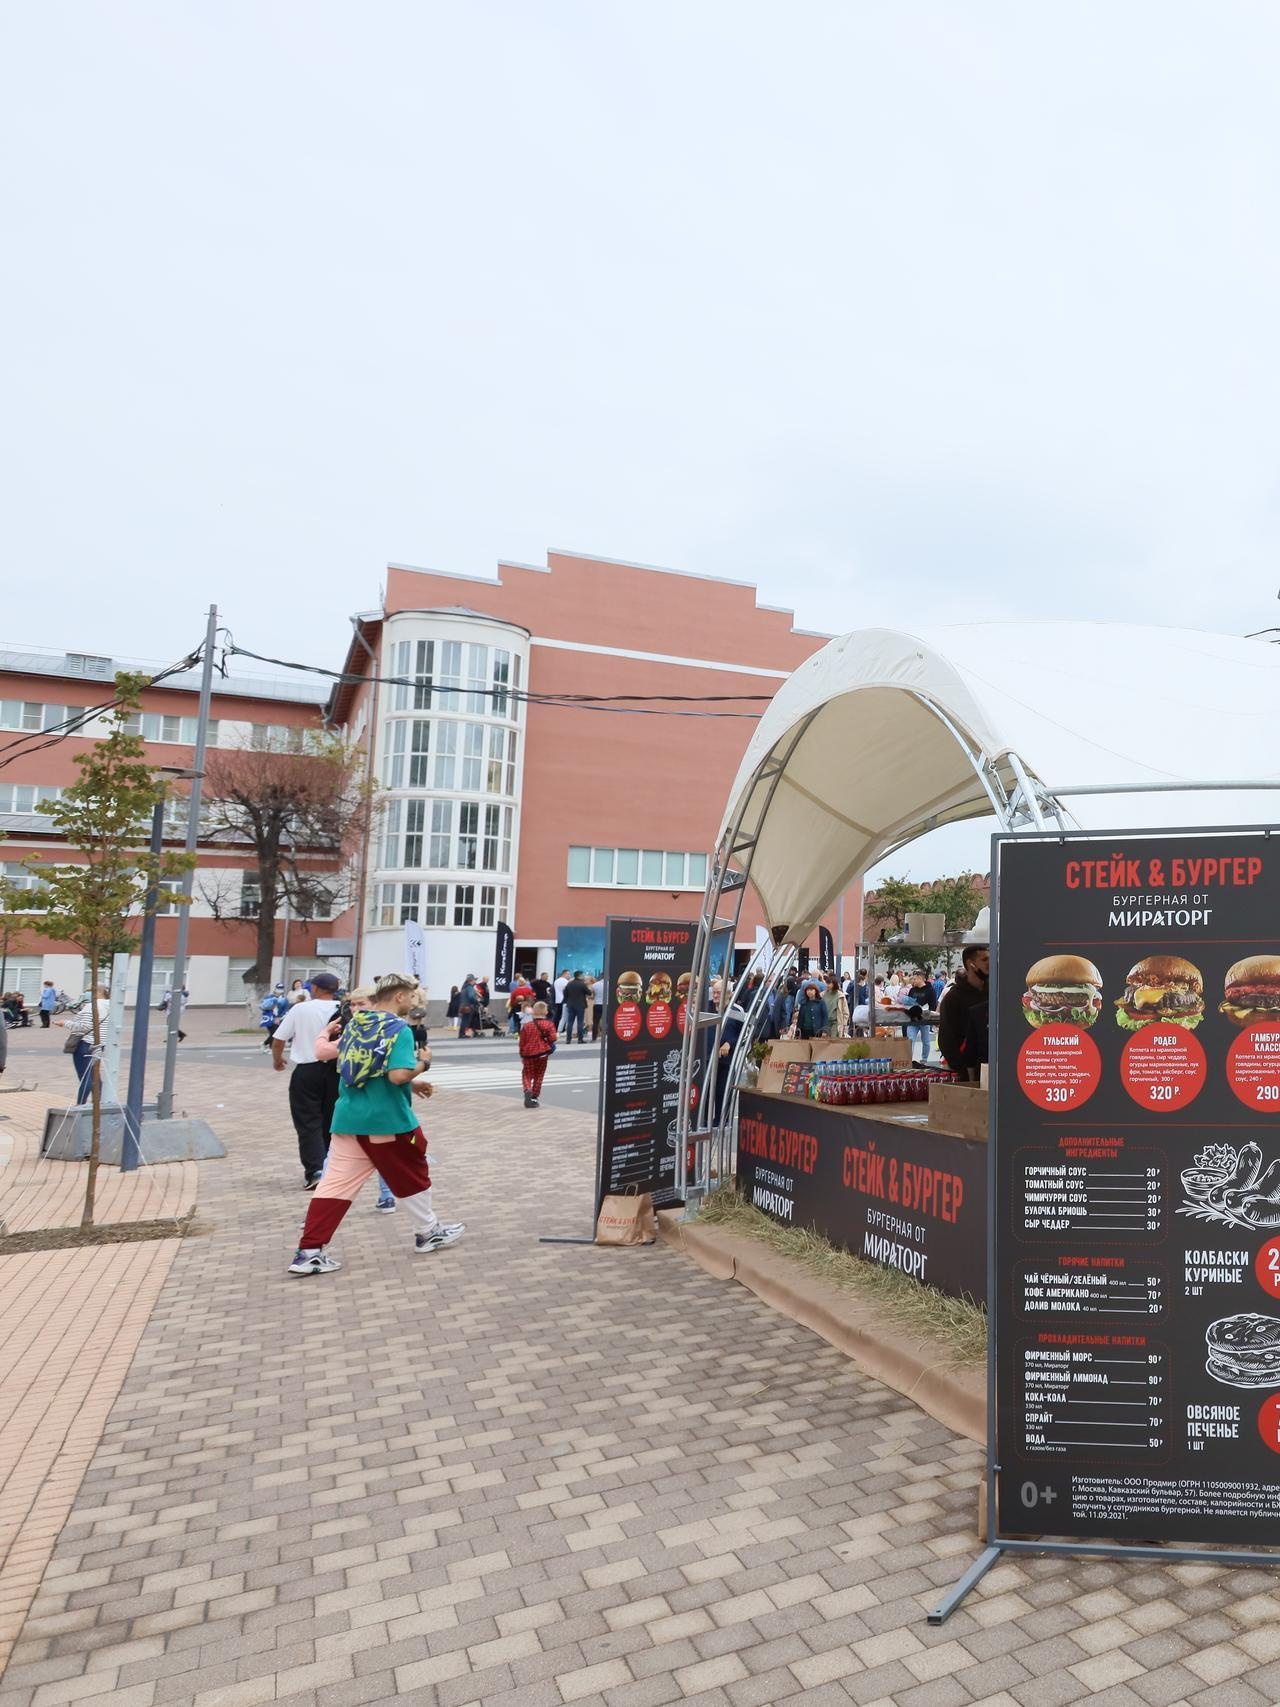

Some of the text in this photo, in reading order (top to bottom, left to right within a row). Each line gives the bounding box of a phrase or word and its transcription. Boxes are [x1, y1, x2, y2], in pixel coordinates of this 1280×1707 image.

[1066, 853, 1263, 888] СТЕЙК & БУРГЕР
[1113, 894, 1209, 906] БУРГЕРНАЯ ОТ
[1108, 909, 1212, 926] МИРАТОРГ
[1043, 1035, 1079, 1045] ТУЛЬСКИЙ
[1153, 1036, 1177, 1046] РОДЕО
[1046, 1088, 1067, 1102] 330
[1150, 1086, 1172, 1100] 320
[1257, 1086, 1279, 1100] 290
[740, 1112, 818, 1174] СТЕЙК & БУРГЕР
[1024, 1165, 1066, 1176] ГОРЧИЧНЫЙ
[1068, 1167, 1087, 1176] СОУС
[755, 1166, 794, 1192] БУРГЕРНАЯ ОТ
[843, 1141, 963, 1224] СТЕЙК & БУРГЕР
[1024, 1178, 1064, 1189] ТОМАТНЫЙ
[1066, 1180, 1084, 1189] СОУС
[752, 1185, 794, 1221] МИРАТОРГ
[1024, 1193, 1067, 1202] ЧИМИЧУРРИ
[1070, 1194, 1088, 1203] СОУС
[1024, 1206, 1056, 1216] БУЛОЧКА
[1058, 1207, 1087, 1216] БРИОШЬ
[867, 1208, 926, 1244] БУРГЕРНАЯ ОТ
[1024, 1219, 1040, 1229] СЫР
[1042, 1220, 1070, 1230] ЧЕДДЕР
[864, 1231, 928, 1280] МИРАТОРГ
[1185, 1250, 1249, 1266] КОЛБАСКИ
[1024, 1272, 1038, 1284] ЧАЙ
[1185, 1268, 1242, 1283] КУРИНЫЕ
[1024, 1288, 1044, 1297] КОФЕ
[1046, 1288, 1089, 1298] АМЕРИКАНО
[1185, 1287, 1203, 1296] 2 ШТ
[1024, 1301, 1049, 1311] ДОЛИВ
[1051, 1301, 1081, 1311] МОЛОКА
[1025, 1350, 1070, 1361] ФИРМЕННЫЙ
[1072, 1352, 1093, 1362] МОРС
[1025, 1371, 1070, 1382] ФИРМЕННЫЙ
[1072, 1373, 1108, 1384] ЛИМОНАД
[1025, 1392, 1066, 1402] КОКА-КОЛА
[1025, 1412, 1053, 1423] СПРАЙТ
[1187, 1405, 1240, 1421] ОВСЯНОЕ
[1187, 1422, 1239, 1438] ПЕЧЕНЬЕ
[1026, 1434, 1045, 1444] ВОДА
[1187, 1441, 1204, 1451] 1 ШТ
[1072, 1476, 1122, 1485] Изготовитель:
[1124, 1478, 1141, 1486] ООО
[1142, 1478, 1177, 1488] Продмир
[1178, 1479, 1200, 1489] (ОГРН
[1202, 1481, 1261, 1491] 1105009001932,
[1021, 1481, 1057, 1508] 0+
[1078, 1485, 1107, 1494] Москва,
[1108, 1486, 1150, 1495] Кавказский
[1151, 1488, 1183, 1497] бульвар,
[1185, 1489, 1198, 1497] 57).
[1223, 1491, 1266, 1500] подробную
[1072, 1494, 1087, 1502] цию
[1095, 1495, 1126, 1503] товарах,
[1127, 1496, 1177, 1505] изготовителе,
[1179, 1498, 1209, 1506] составе,
[1210, 1500, 1264, 1509] калорийности
[1072, 1503, 1106, 1512] получить
[1113, 1504, 1159, 1513] сотрудников
[1161, 1506, 1202, 1515] бургерной.
[1215, 1509, 1248, 1517] является
[1089, 1511, 1128, 1520] 11.09.2021.
